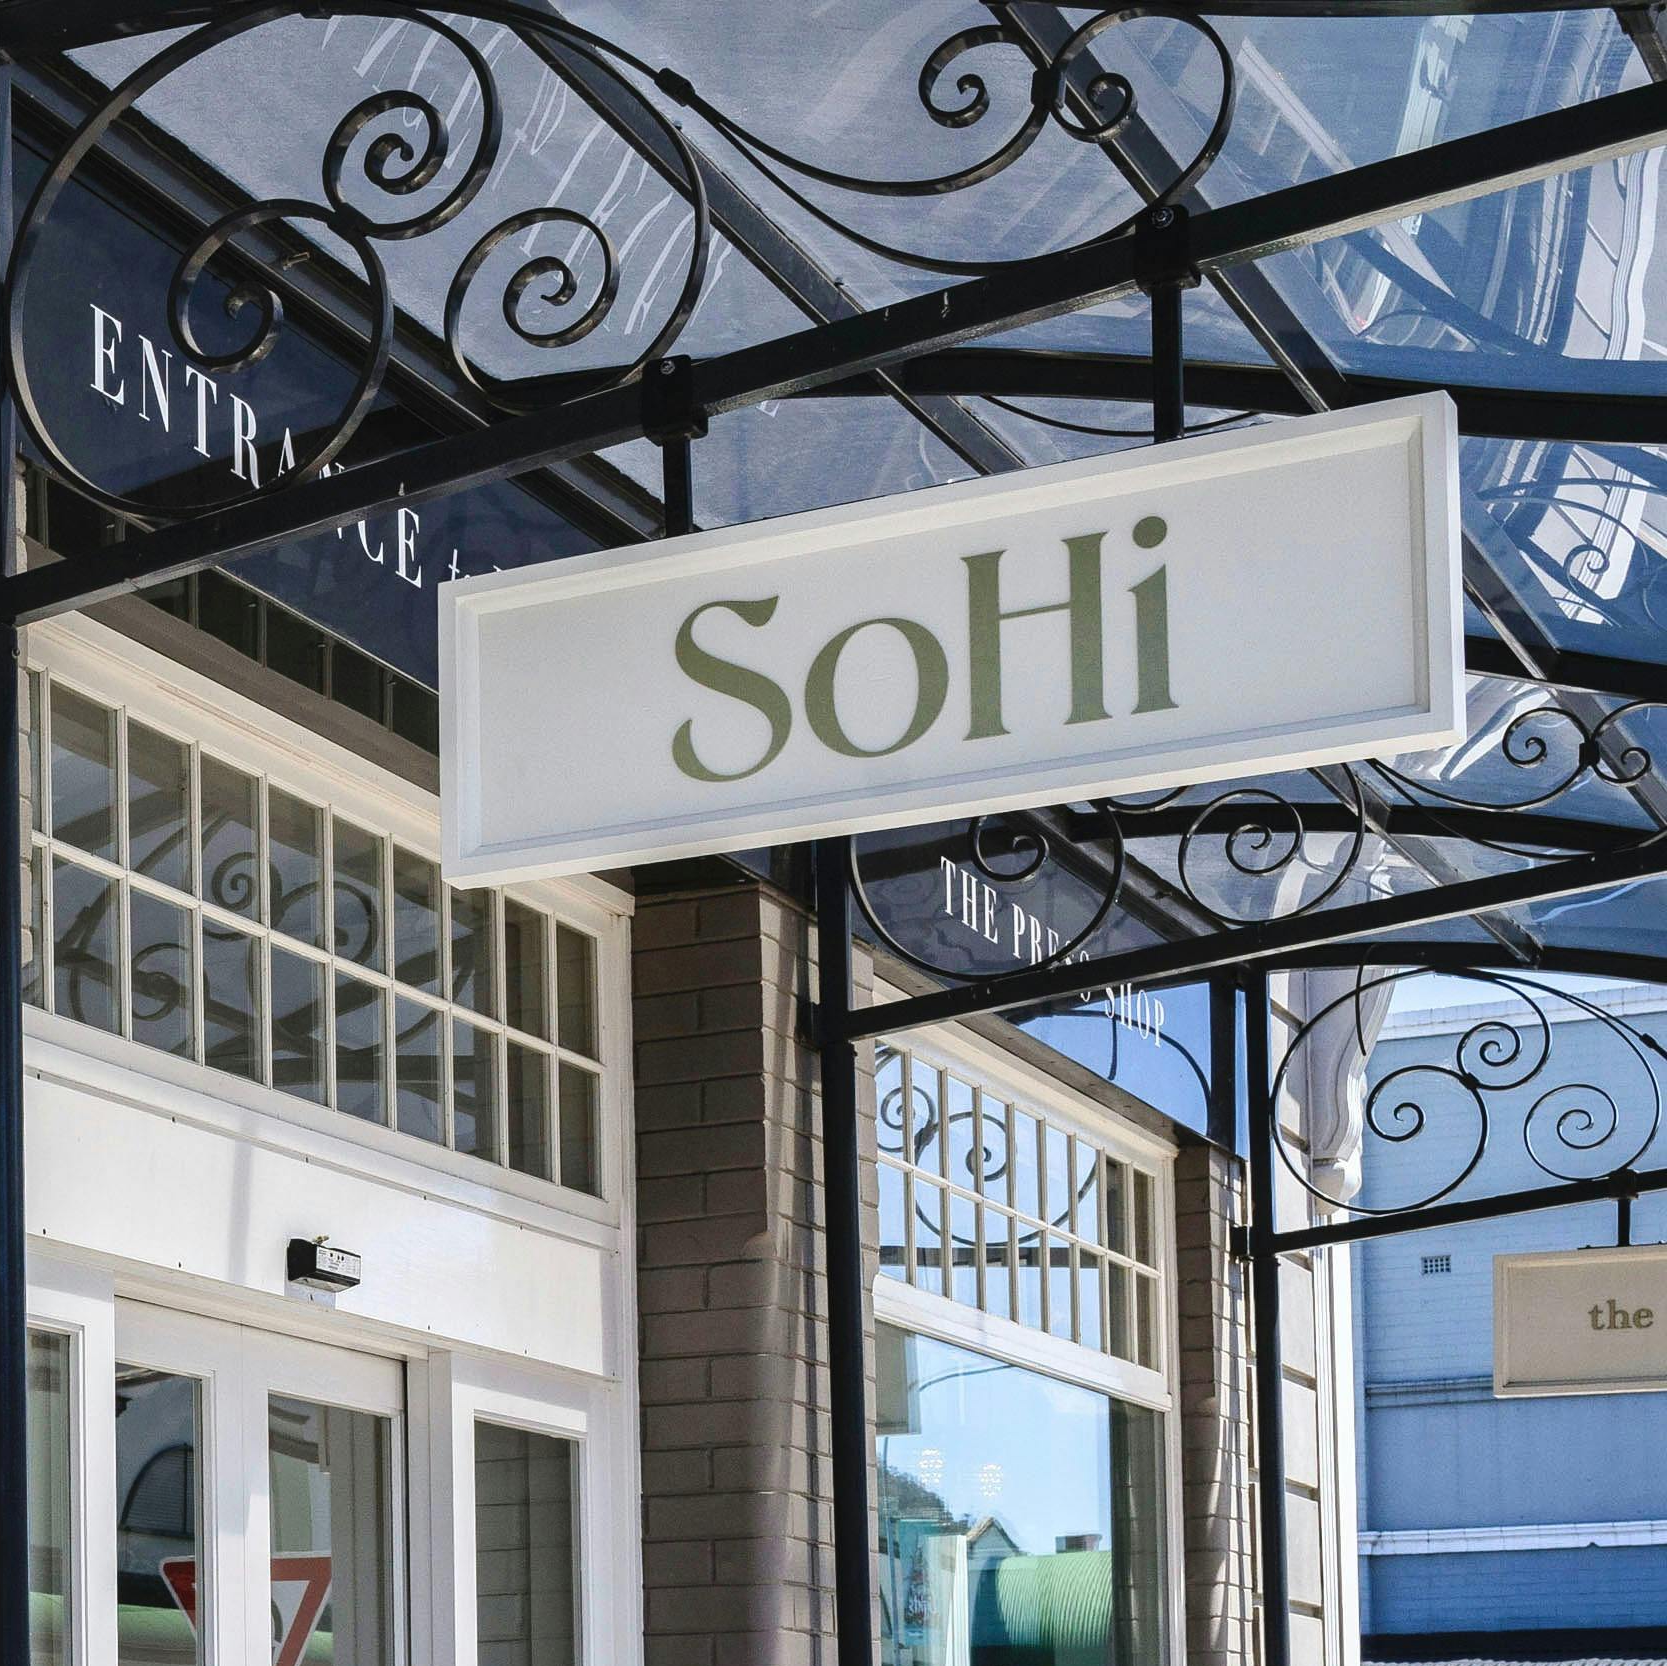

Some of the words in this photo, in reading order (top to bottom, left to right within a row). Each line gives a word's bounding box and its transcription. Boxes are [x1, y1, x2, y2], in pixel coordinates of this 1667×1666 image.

[90, 303, 422, 589] ENTRACE
[671, 515, 1180, 783] SoHi
[940, 855, 999, 945] THE
[1104, 982, 1165, 1049] SHOP
[1587, 1299, 1654, 1331] the
